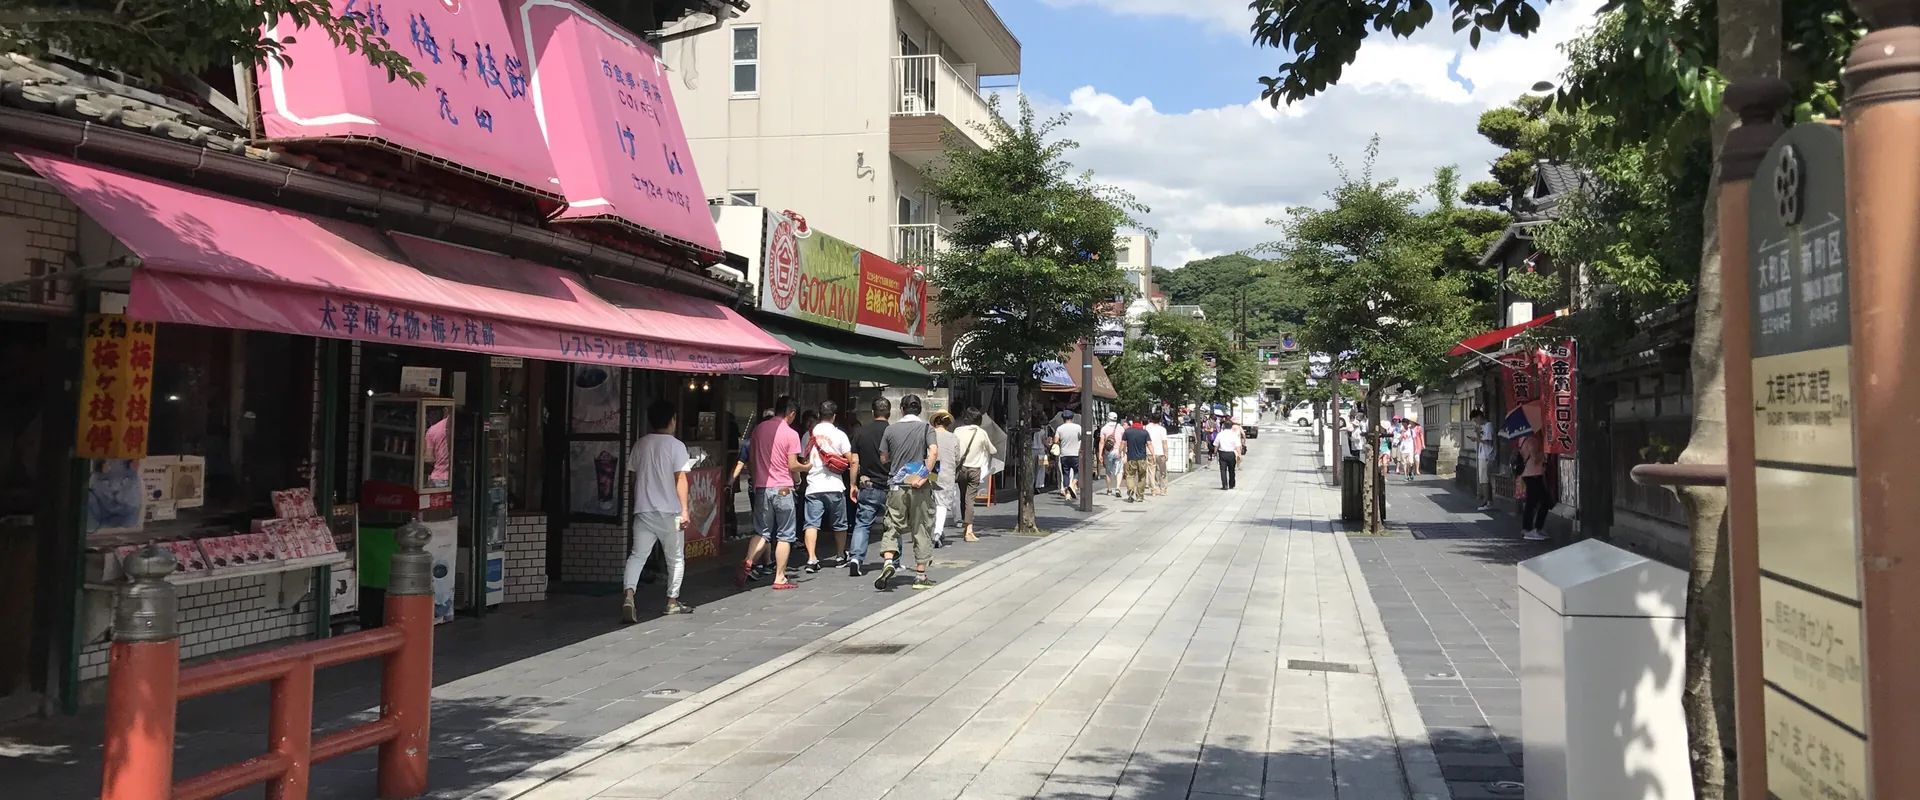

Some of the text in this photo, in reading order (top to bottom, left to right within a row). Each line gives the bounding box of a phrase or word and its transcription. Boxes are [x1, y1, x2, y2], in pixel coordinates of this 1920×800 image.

[798, 272, 856, 325] GOKAKU
[1766, 368, 1830, 406] 太宰府天満宮
